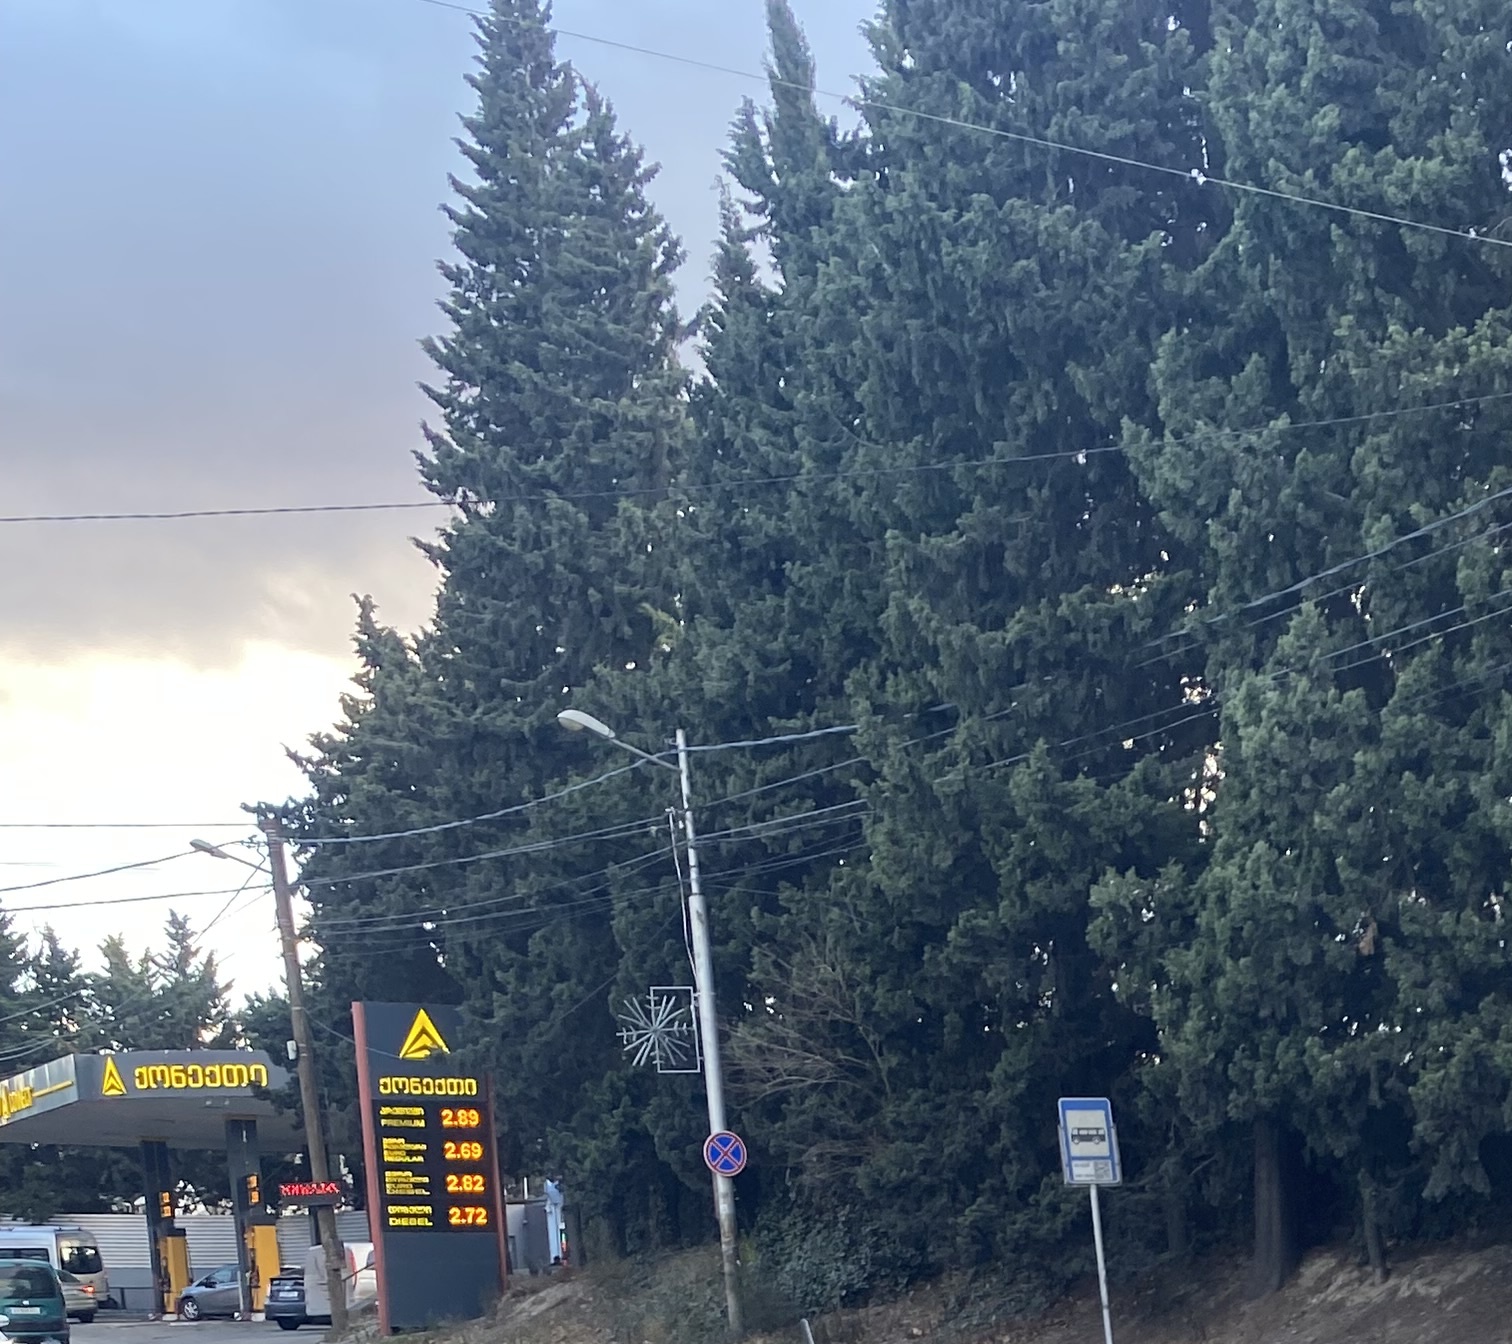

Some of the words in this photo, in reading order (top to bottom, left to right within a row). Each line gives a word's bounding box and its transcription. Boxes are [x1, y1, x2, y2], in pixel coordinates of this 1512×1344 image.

[379, 1077, 477, 1095] ქონექთი
[441, 1108, 481, 1127] 2.89
[444, 1141, 484, 1160] 2.69
[446, 1174, 486, 1193] 2.82
[448, 1206, 489, 1226] 2.72
